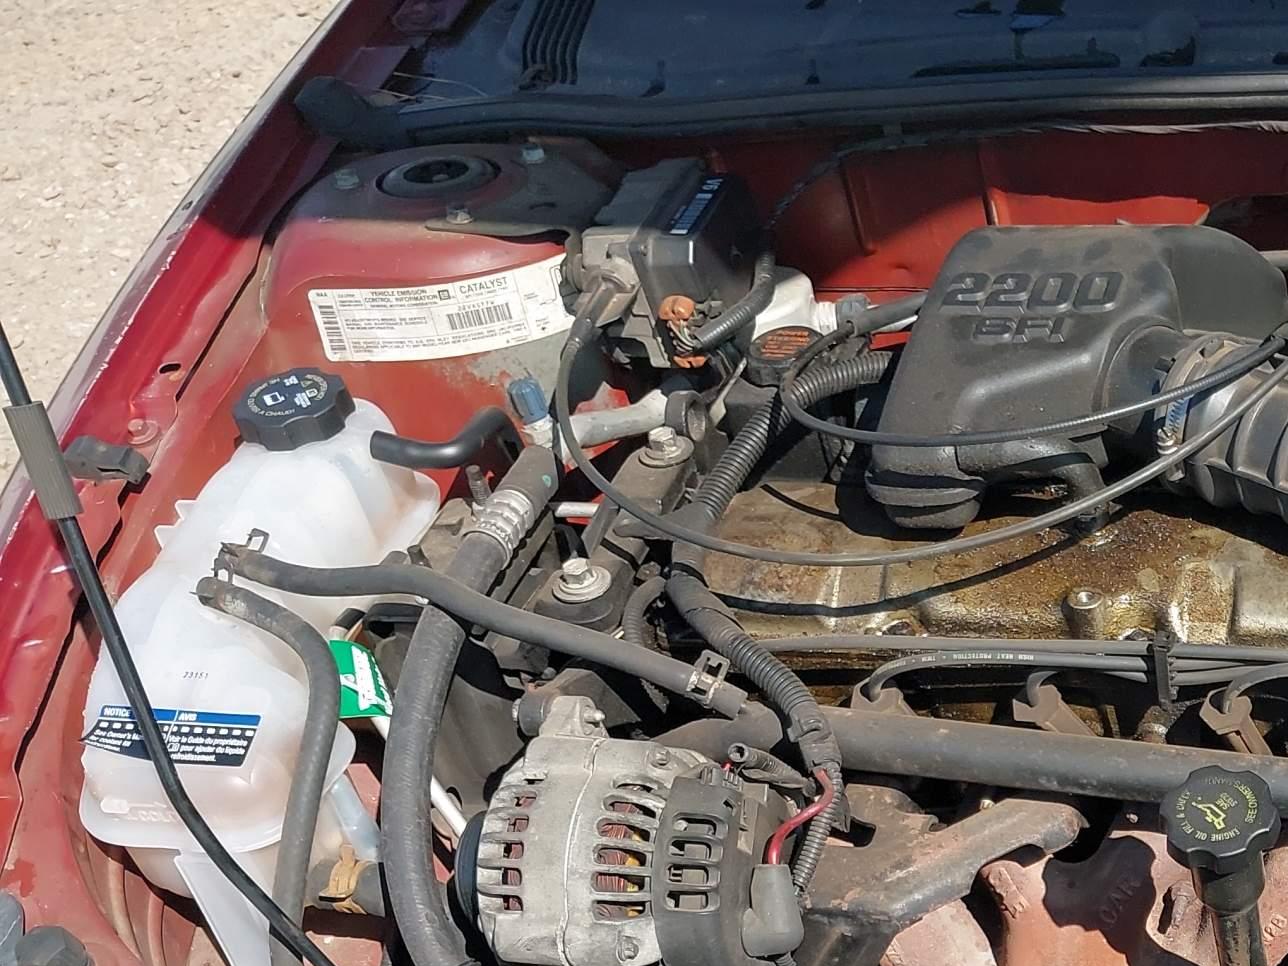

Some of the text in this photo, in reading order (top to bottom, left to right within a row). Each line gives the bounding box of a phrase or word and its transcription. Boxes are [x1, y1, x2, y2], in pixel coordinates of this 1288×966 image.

[459, 277, 508, 294] CATALYST
[941, 272, 1124, 312] 2200
[103, 707, 198, 721] NOTICE AVIS
[1244, 808, 1257, 824] SEE
[1180, 820, 1195, 834] FILL
[1210, 826, 1241, 842] ENGINE
[1195, 830, 1208, 841] OIL
